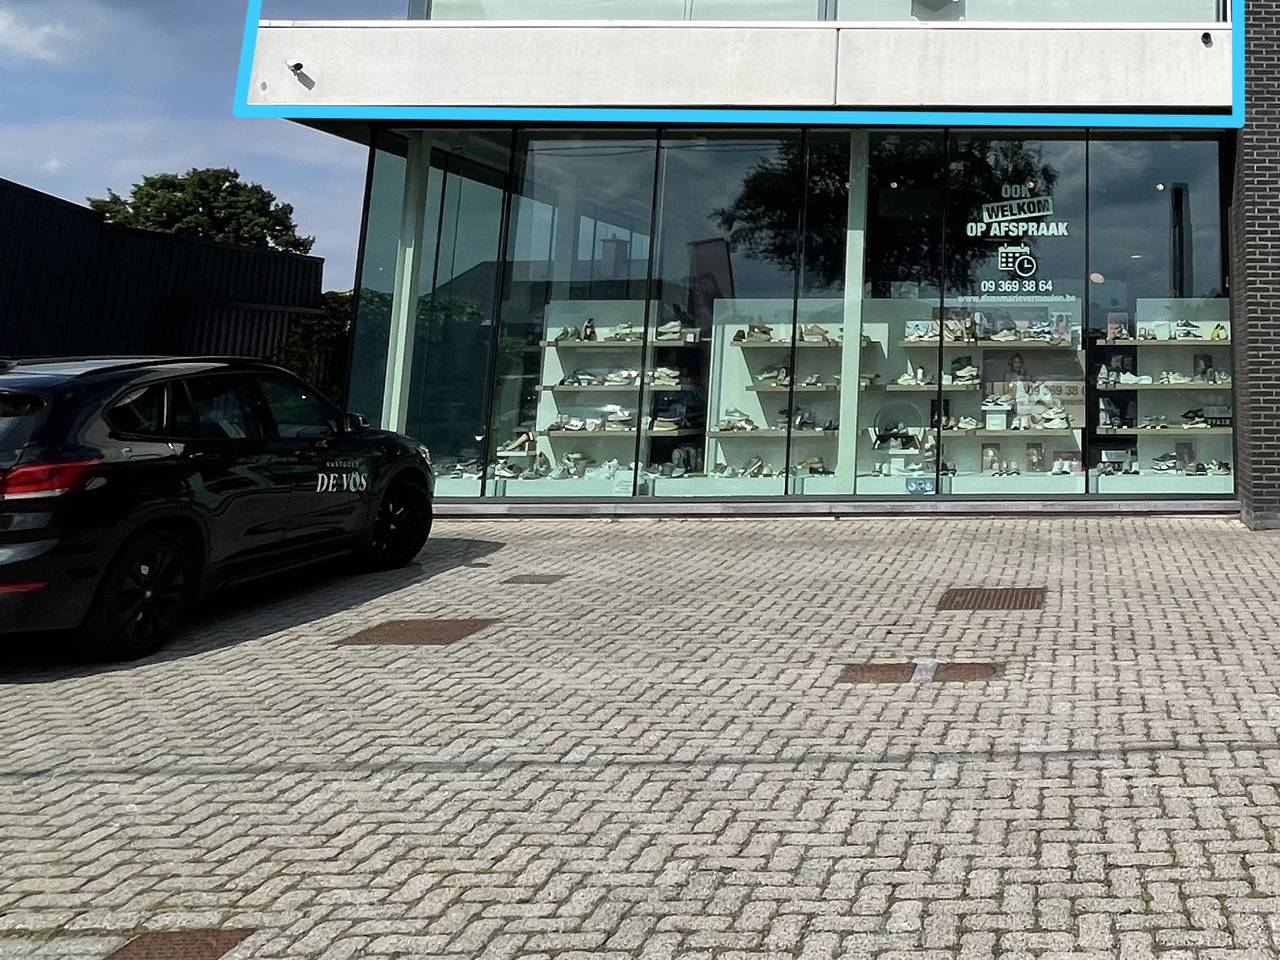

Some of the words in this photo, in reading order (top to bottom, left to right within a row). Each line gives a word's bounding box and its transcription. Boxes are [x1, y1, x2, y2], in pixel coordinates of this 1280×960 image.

[1001, 184, 1031, 198] OOK
[985, 199, 1051, 220] WELKOM
[966, 222, 987, 237] OP
[989, 222, 1069, 237] AFSPRAAK
[981, 280, 996, 292] 09
[998, 280, 1020, 292] 369
[1022, 280, 1036, 292] 38
[1038, 280, 1053, 292] 64
[316, 473, 338, 492] DE
[341, 471, 368, 493] VOS
